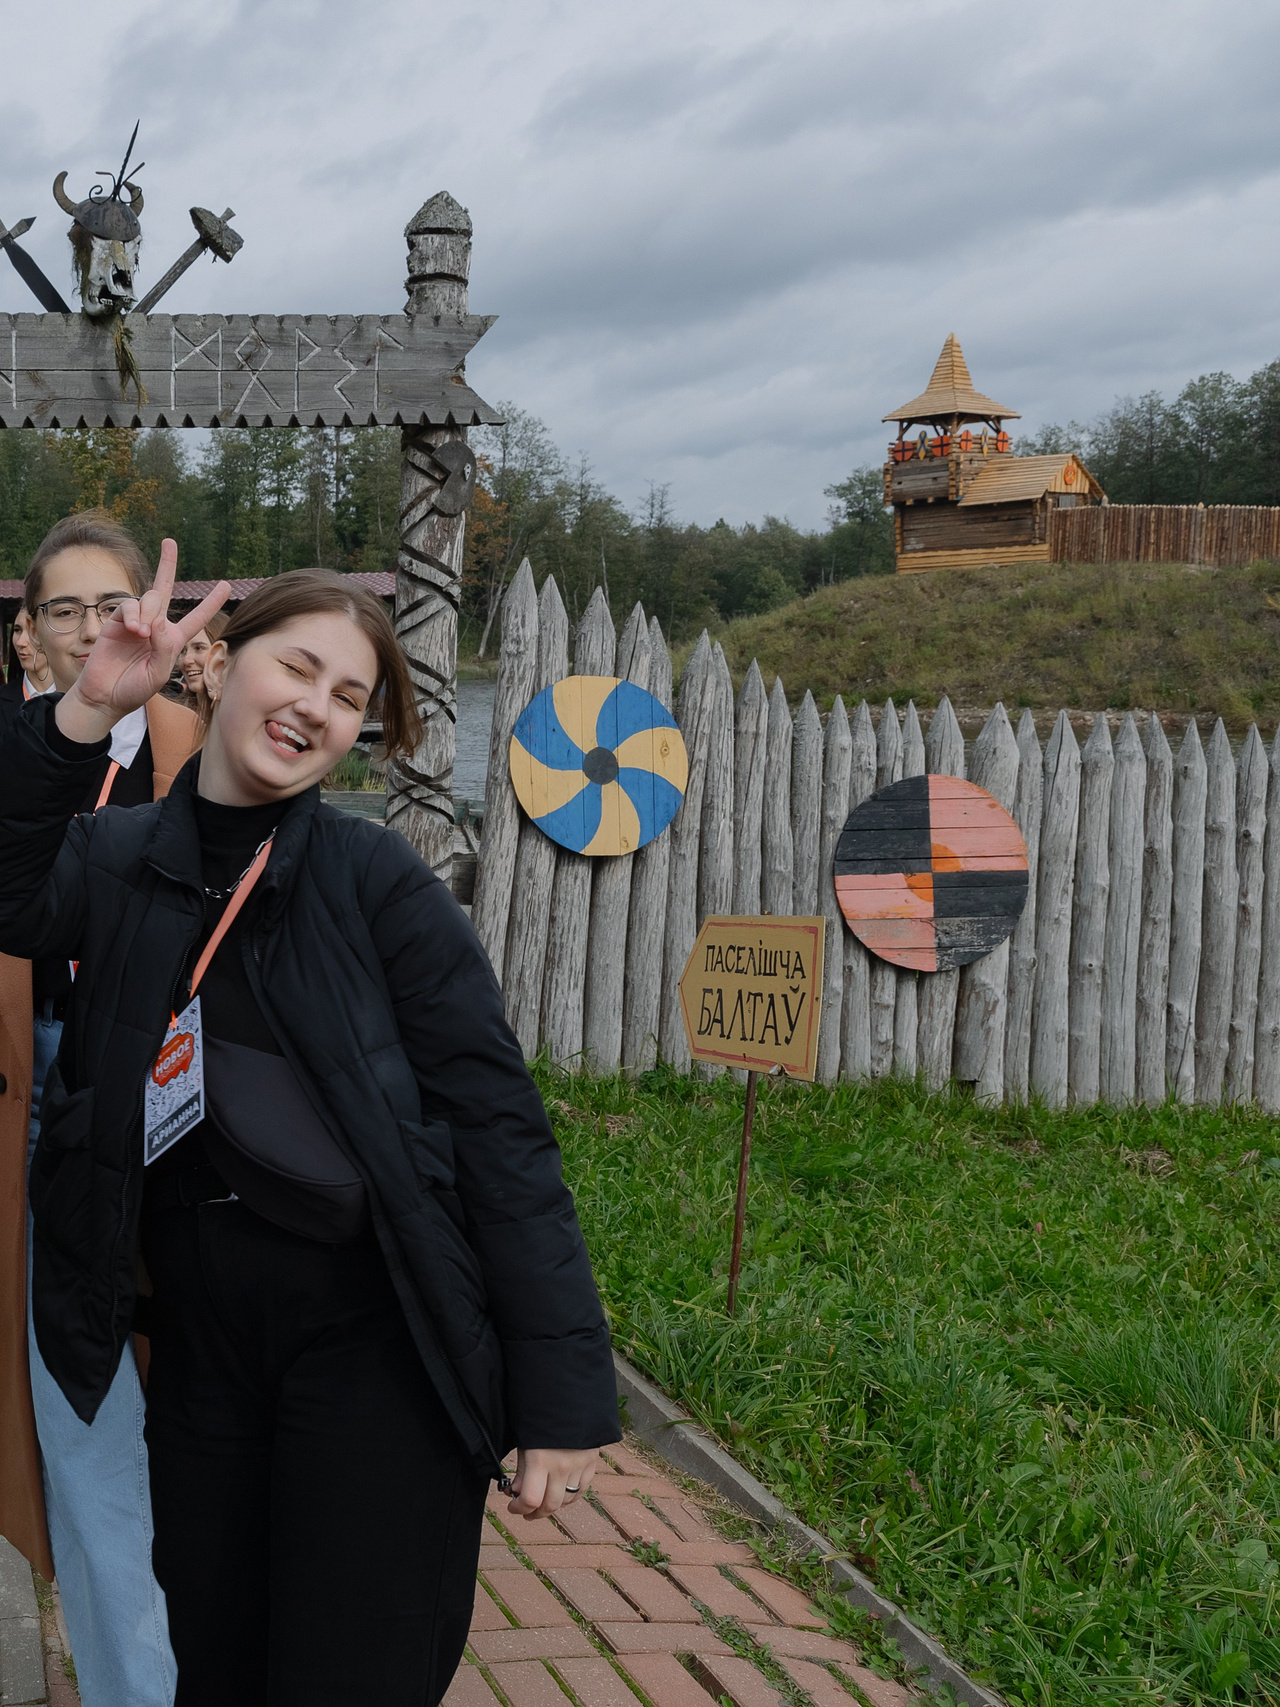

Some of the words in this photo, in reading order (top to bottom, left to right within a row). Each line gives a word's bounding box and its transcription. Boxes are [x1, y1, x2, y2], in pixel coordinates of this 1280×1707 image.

[704, 939, 806, 980] ПАСЕЛІШЧА
[697, 984, 806, 1046] БАЛТАЎ
[155, 1038, 190, 1077] НОВОЕ
[151, 1101, 200, 1148] АРИАННА
